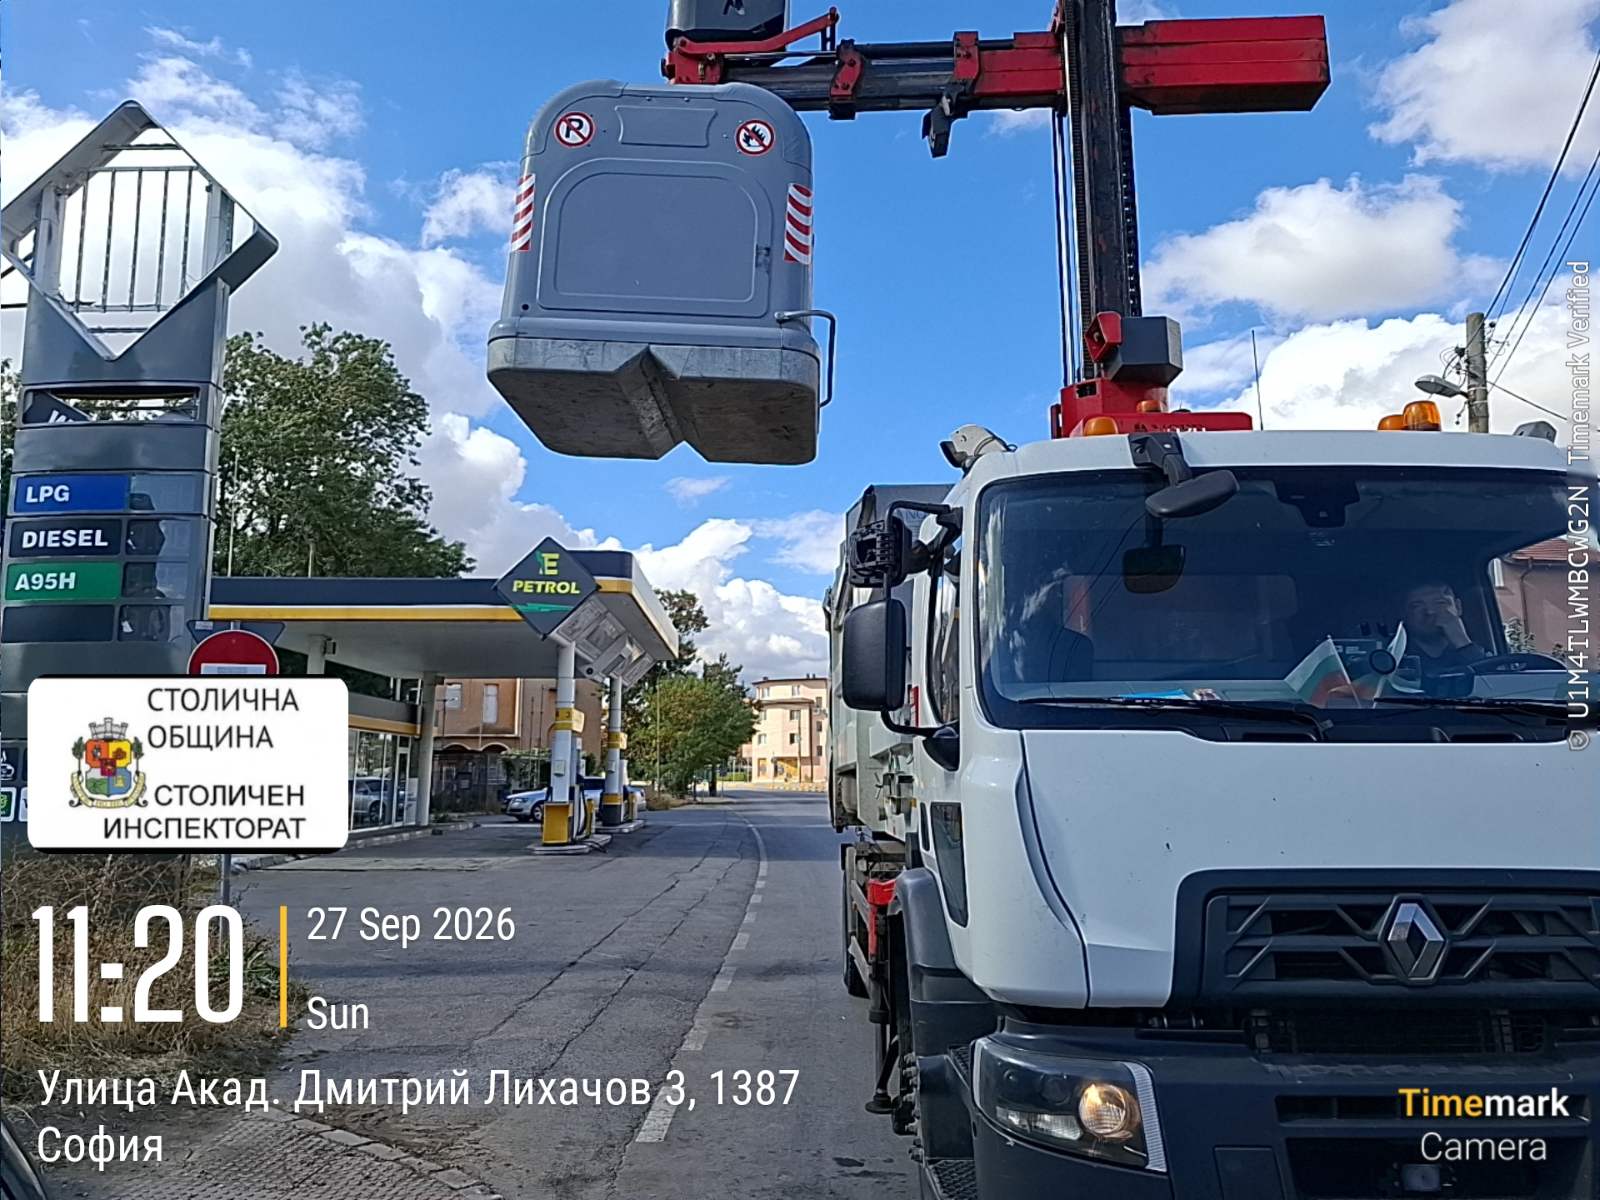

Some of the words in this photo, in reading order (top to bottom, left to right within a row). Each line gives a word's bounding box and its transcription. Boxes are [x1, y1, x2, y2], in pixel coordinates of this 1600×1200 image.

[25, 485, 70, 503] LPG
[22, 529, 108, 549] DIESEL
[14, 572, 75, 591] A95H
[512, 580, 581, 594] PETROL
